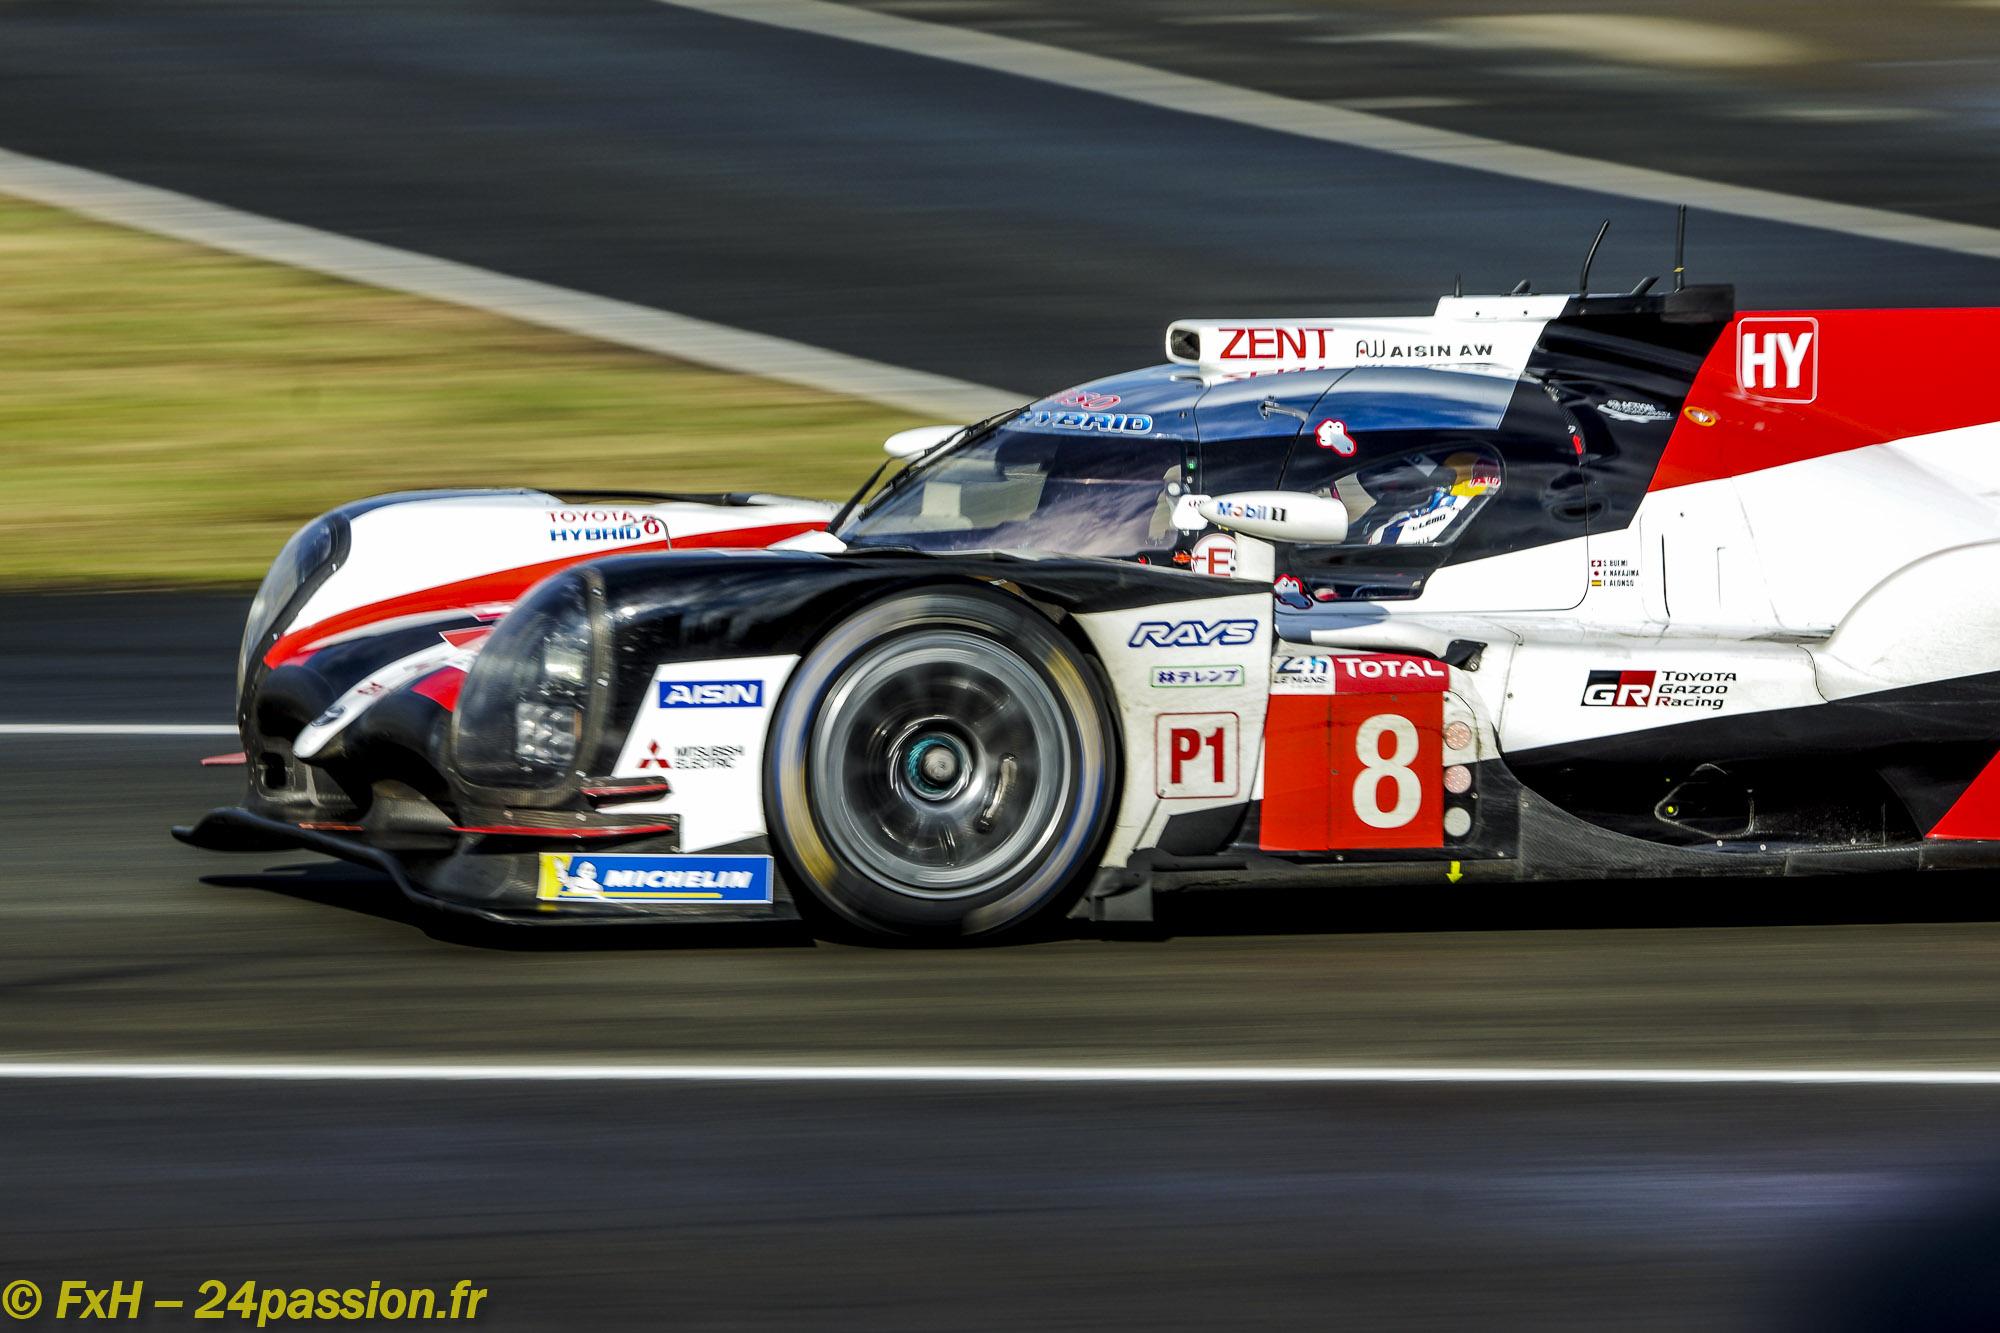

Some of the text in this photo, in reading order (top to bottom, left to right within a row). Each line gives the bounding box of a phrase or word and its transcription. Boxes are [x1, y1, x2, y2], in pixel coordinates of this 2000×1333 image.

[1217, 327, 1334, 359] ZENT
[1390, 345, 1451, 358] AISIN
[1459, 344, 1493, 356] AW
[1742, 333, 1813, 388] HY
[1009, 411, 1153, 434] HYBRID
[546, 511, 637, 523] TOYOTA
[1217, 502, 1267, 520] Mobil
[550, 526, 641, 541] HYBRID
[1208, 547, 1231, 577] E
[1128, 619, 1258, 648] RAYS
[1276, 655, 1327, 674] 24h
[1337, 657, 1445, 679] TOTAL
[1291, 676, 1327, 684] MANS
[1662, 670, 1737, 681] TOYOTA
[663, 683, 759, 705] AISIN
[1582, 683, 1651, 707] GR
[1658, 684, 1728, 694] GAZOO
[1655, 696, 1724, 710] Racing
[675, 745, 745, 757] MITSUBISHI
[1170, 727, 1225, 784] P1
[675, 758, 736, 769] ELECTRIC
[1352, 713, 1422, 829] 8
[602, 870, 754, 889] MICHELIN
